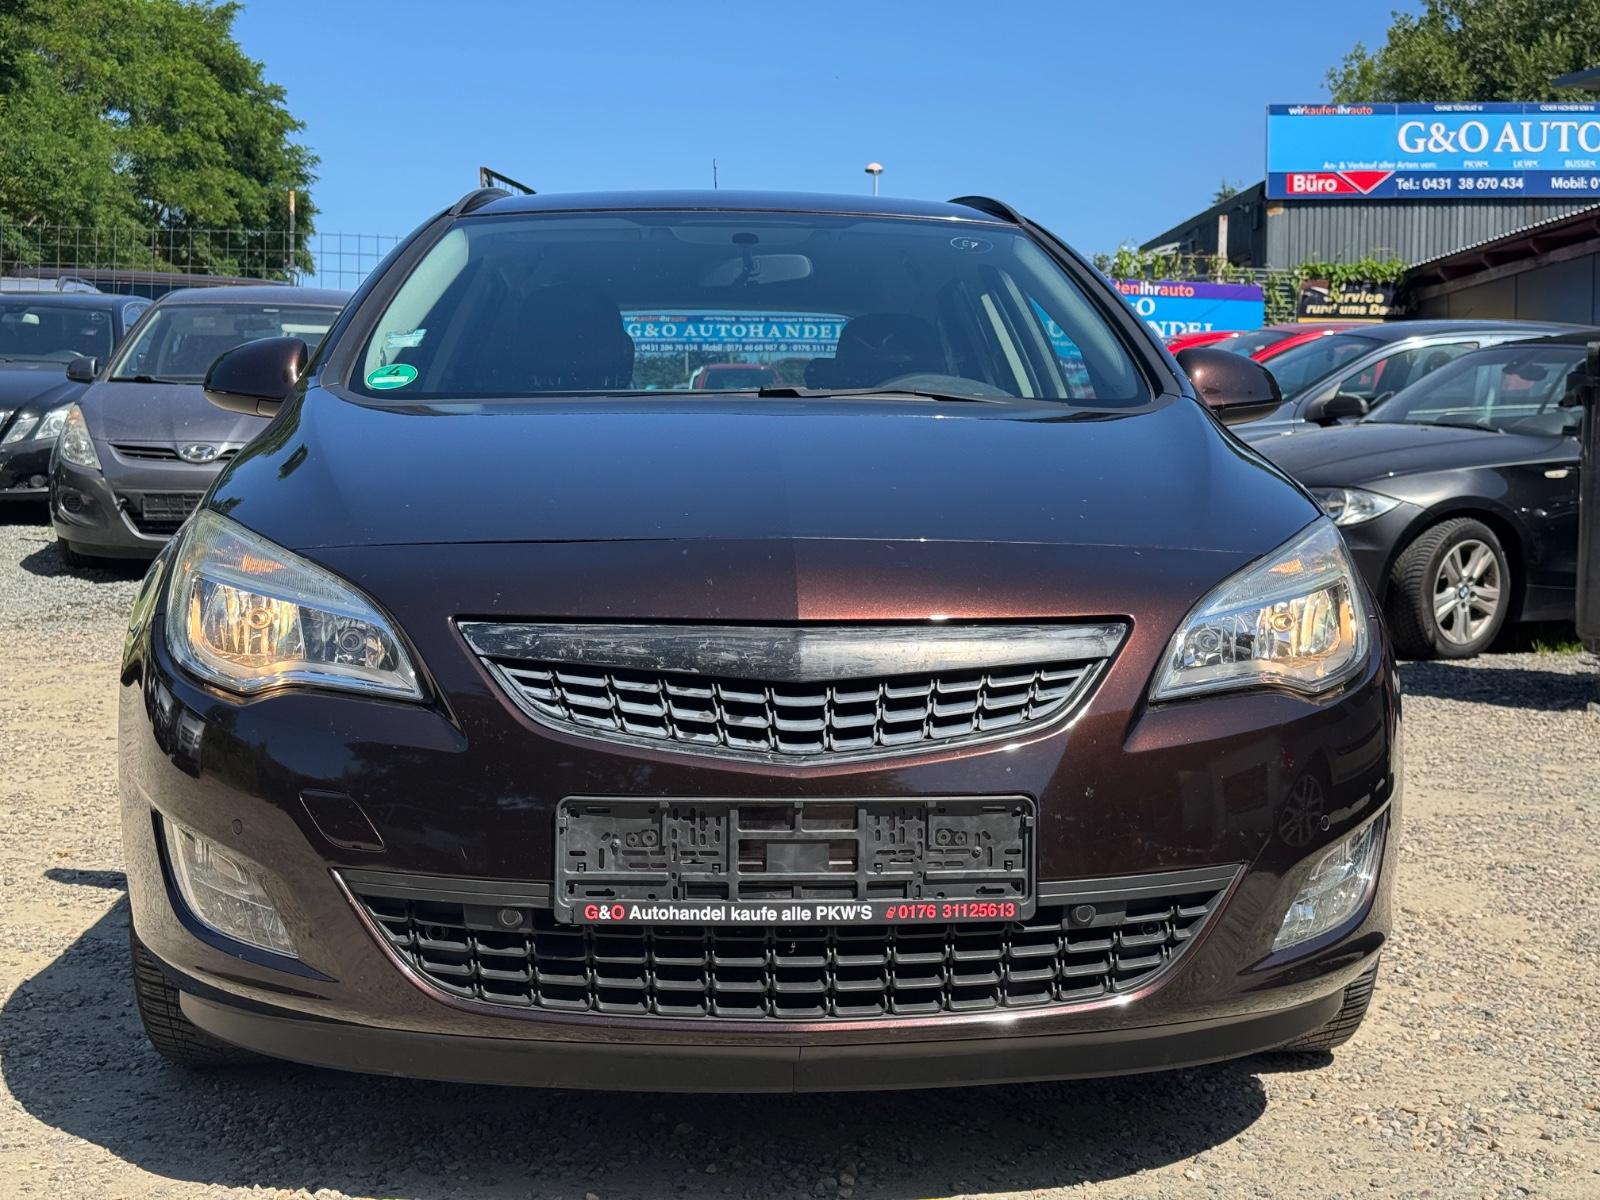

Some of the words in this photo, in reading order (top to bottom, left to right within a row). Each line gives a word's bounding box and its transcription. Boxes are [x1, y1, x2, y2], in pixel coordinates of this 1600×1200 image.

[1288, 105, 1373, 116] wirkaufenihrauto
[1397, 121, 1489, 154] G&O
[1348, 161, 1378, 170] Verkauf
[1292, 174, 1338, 193] Büro
[1396, 178, 1420, 191] Tel.:
[1421, 177, 1451, 191] 0431
[1458, 177, 1475, 190] 38
[1476, 177, 1498, 190] 670
[1500, 177, 1524, 190] 434
[1551, 176, 1588, 190] Mobil:
[627, 323, 677, 337] G&O
[386, 365, 400, 377] 4
[584, 904, 625, 921] G&O
[629, 905, 726, 921] Autohandel
[731, 906, 778, 921] kaufe
[782, 906, 812, 921] alle
[816, 905, 873, 920] PKW'S
[898, 904, 937, 919] 0176
[942, 903, 1015, 918] 31125613
